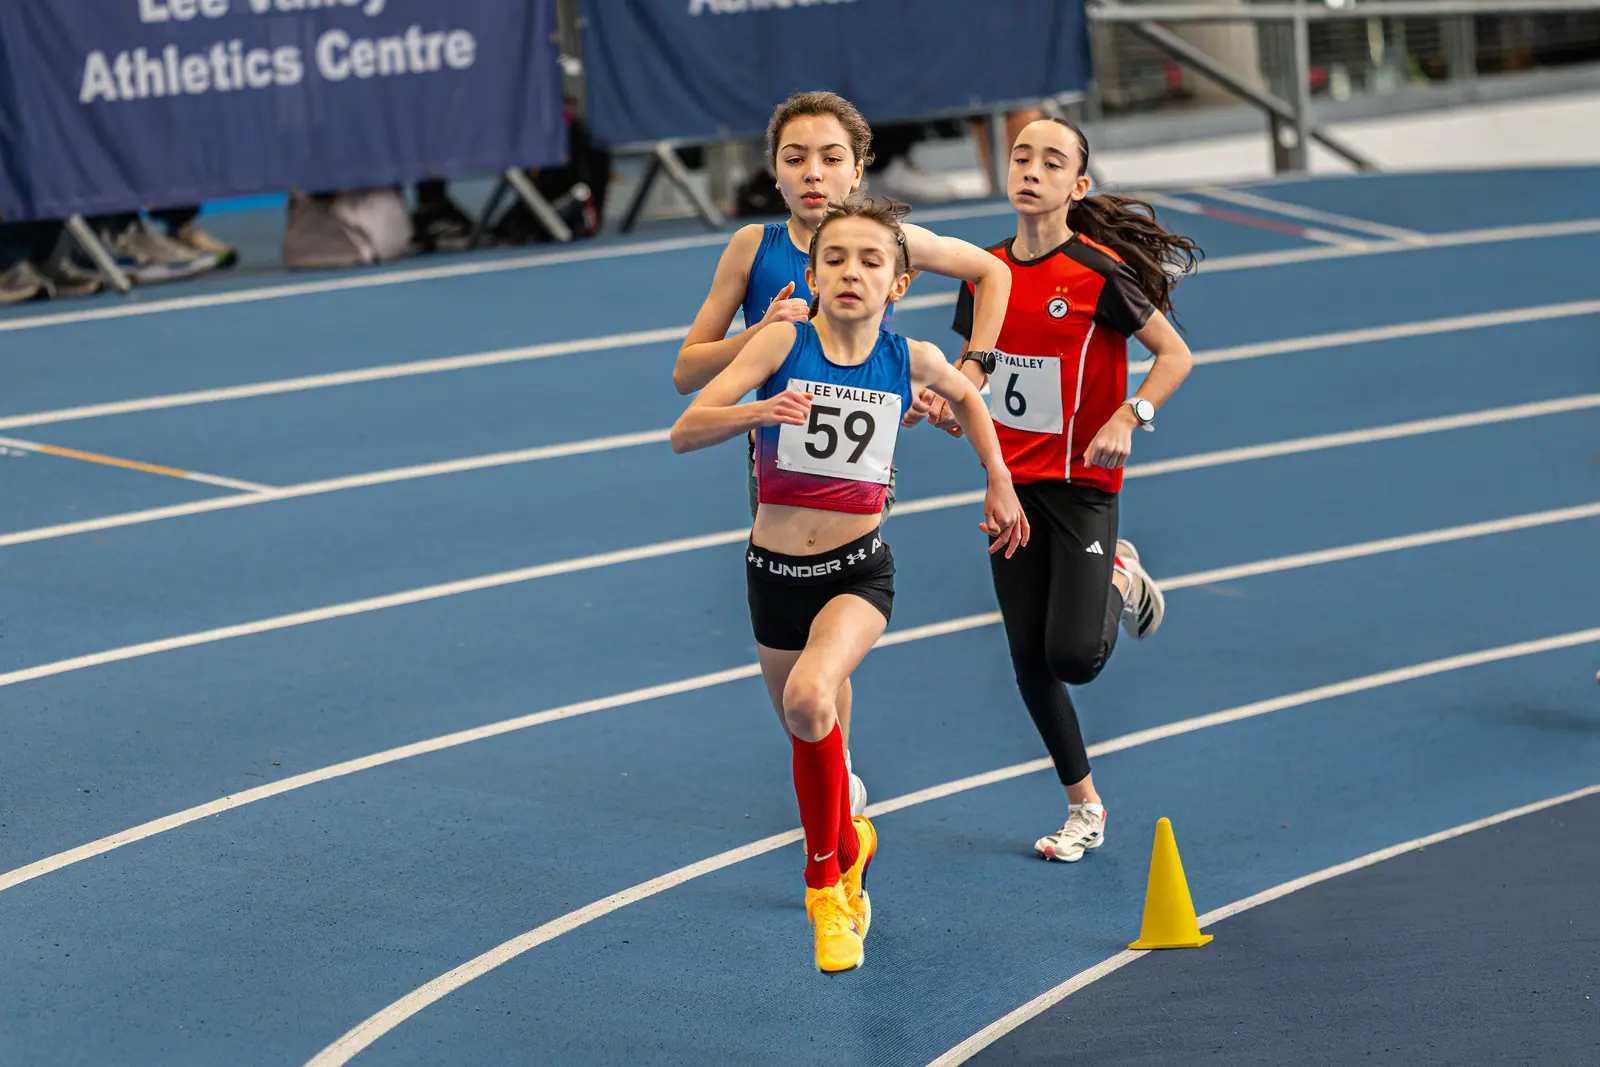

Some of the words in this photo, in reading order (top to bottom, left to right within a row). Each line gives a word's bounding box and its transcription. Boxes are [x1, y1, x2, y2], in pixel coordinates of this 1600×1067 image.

[79, 38, 304, 103] Athletics
[316, 25, 476, 81] Centre
[1004, 356, 1044, 369] VALLEY
[805, 383, 831, 398] LEE
[835, 387, 886, 405] VALLEY
[1005, 373, 1027, 418] 6
[804, 404, 876, 464] 59
[769, 559, 842, 578] UNDER
